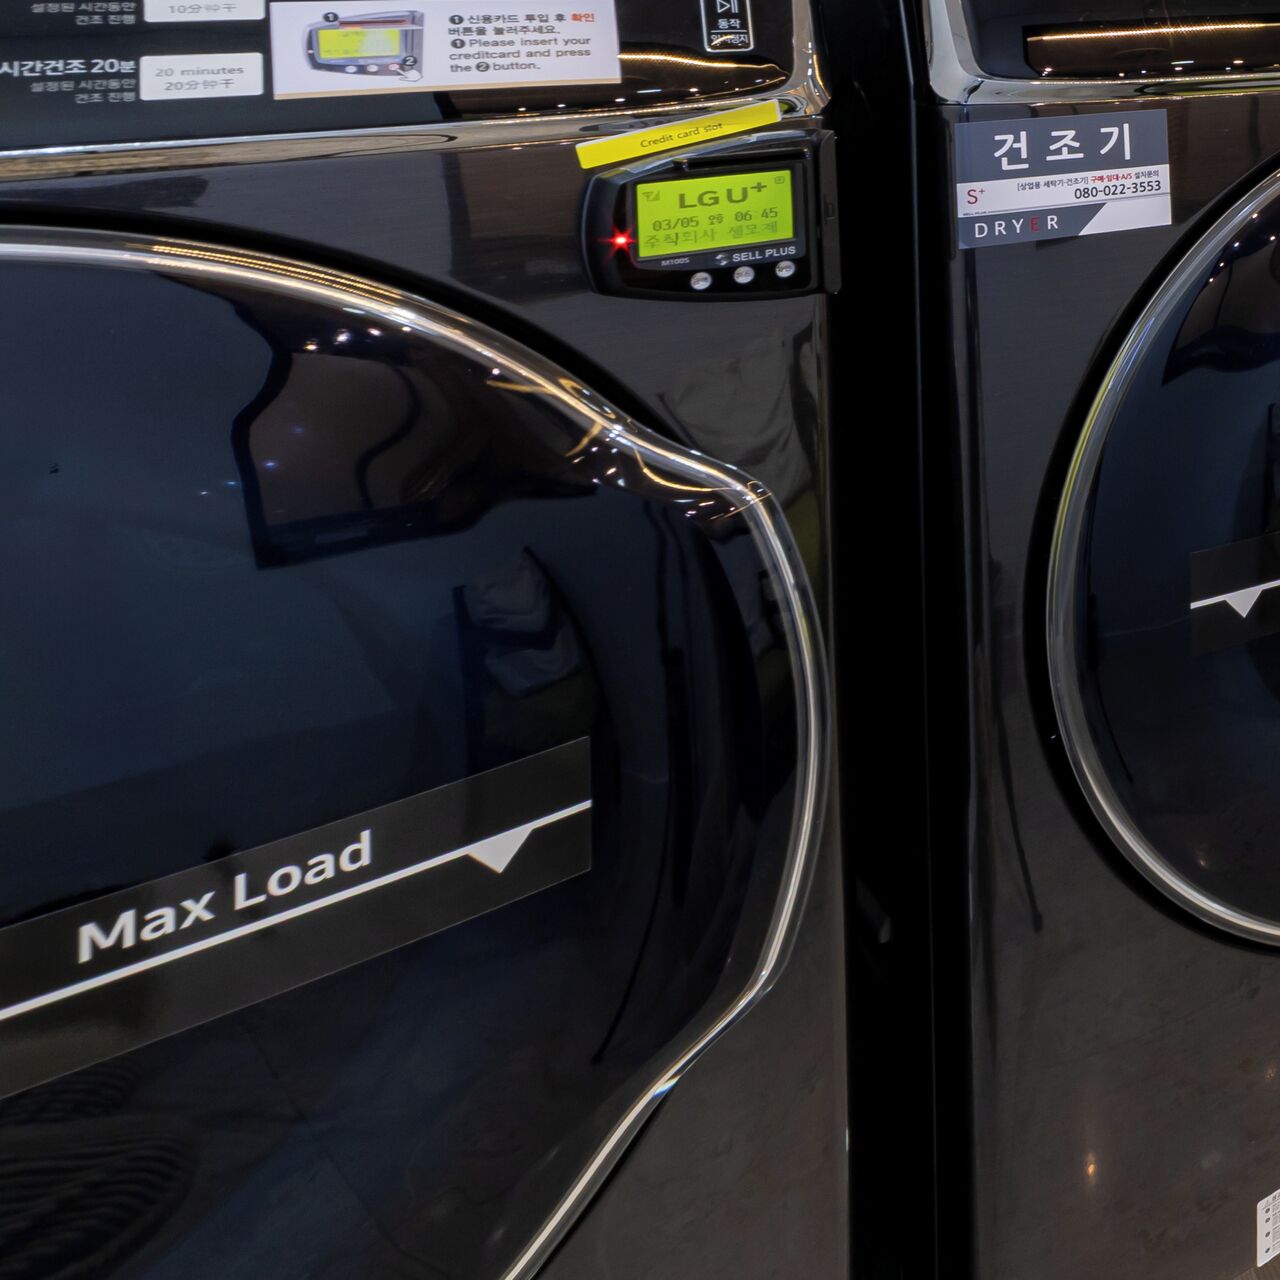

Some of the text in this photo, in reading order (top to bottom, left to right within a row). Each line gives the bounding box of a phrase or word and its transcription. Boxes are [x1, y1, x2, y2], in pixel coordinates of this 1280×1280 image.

[78, 2, 137, 13] 시간동안
[75, 15, 104, 25] 건조
[467, 14, 519, 24] 신용카드
[524, 14, 549, 23] 투입
[555, 13, 567, 22] 후
[570, 12, 595, 23] 확인
[448, 26, 487, 36] 버튼을
[469, 38, 516, 48] Please
[520, 37, 558, 46] insert
[562, 37, 591, 47] your
[449, 49, 591, 61] creditcard and press
[0, 59, 136, 77] 시간건조 20분
[155, 66, 245, 78] 20 minutes
[450, 63, 472, 72] the
[493, 61, 541, 71] button.
[75, 93, 104, 104] 건조
[640, 122, 724, 148] Credit card slot
[993, 123, 1131, 170] 건조기
[1074, 180, 1161, 199] 080-022-3553
[678, 190, 720, 209] LG
[652, 216, 699, 232] 03/05
[734, 211, 752, 222] 06
[761, 207, 778, 219] 45
[974, 215, 1058, 238] DRYER
[732, 246, 796, 263] SELL PLUS
[77, 829, 374, 964] Max Load
